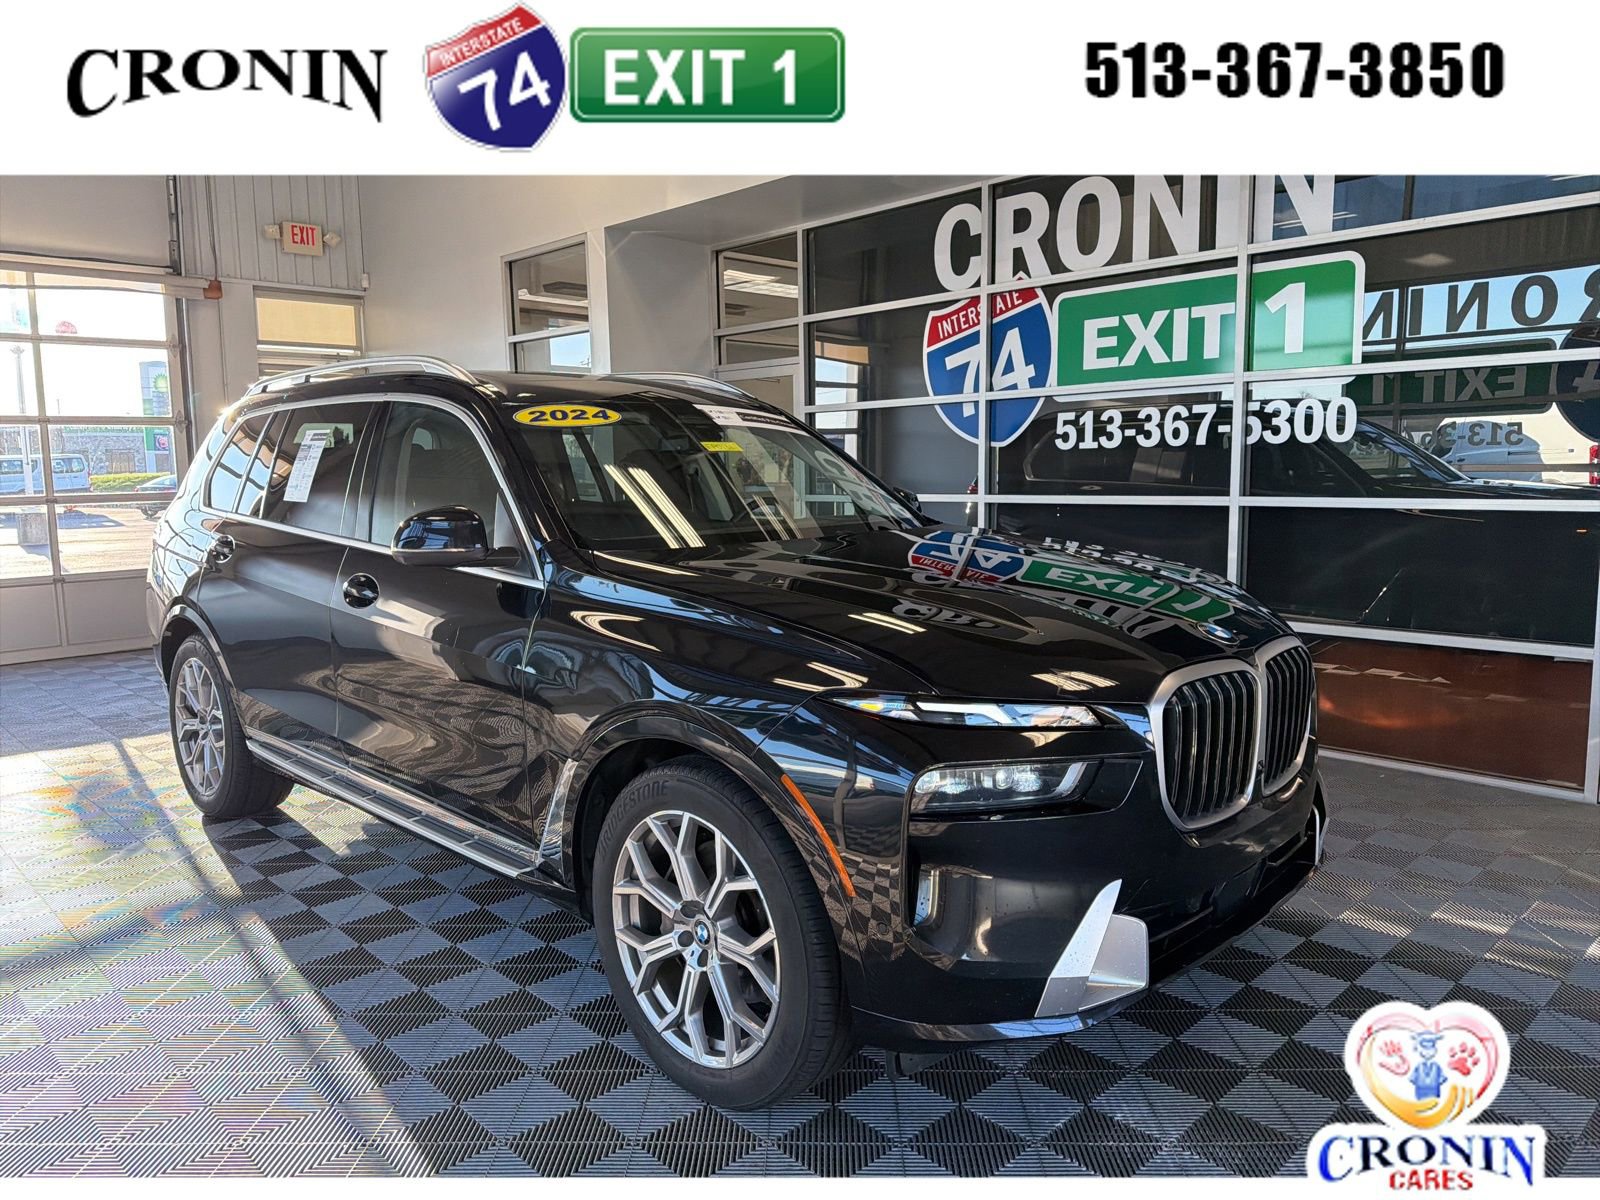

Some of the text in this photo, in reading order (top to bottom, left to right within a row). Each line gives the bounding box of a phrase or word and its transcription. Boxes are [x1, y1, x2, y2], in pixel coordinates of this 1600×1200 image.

[291, 225, 316, 246] EXIT
[934, 175, 1336, 292] CRONIN
[938, 289, 1023, 339] INTERSATE
[1082, 283, 1306, 370] EXIT 1
[945, 327, 1036, 418] 74
[528, 409, 611, 423] 2024
[1054, 397, 1358, 451] 513-367-5300
